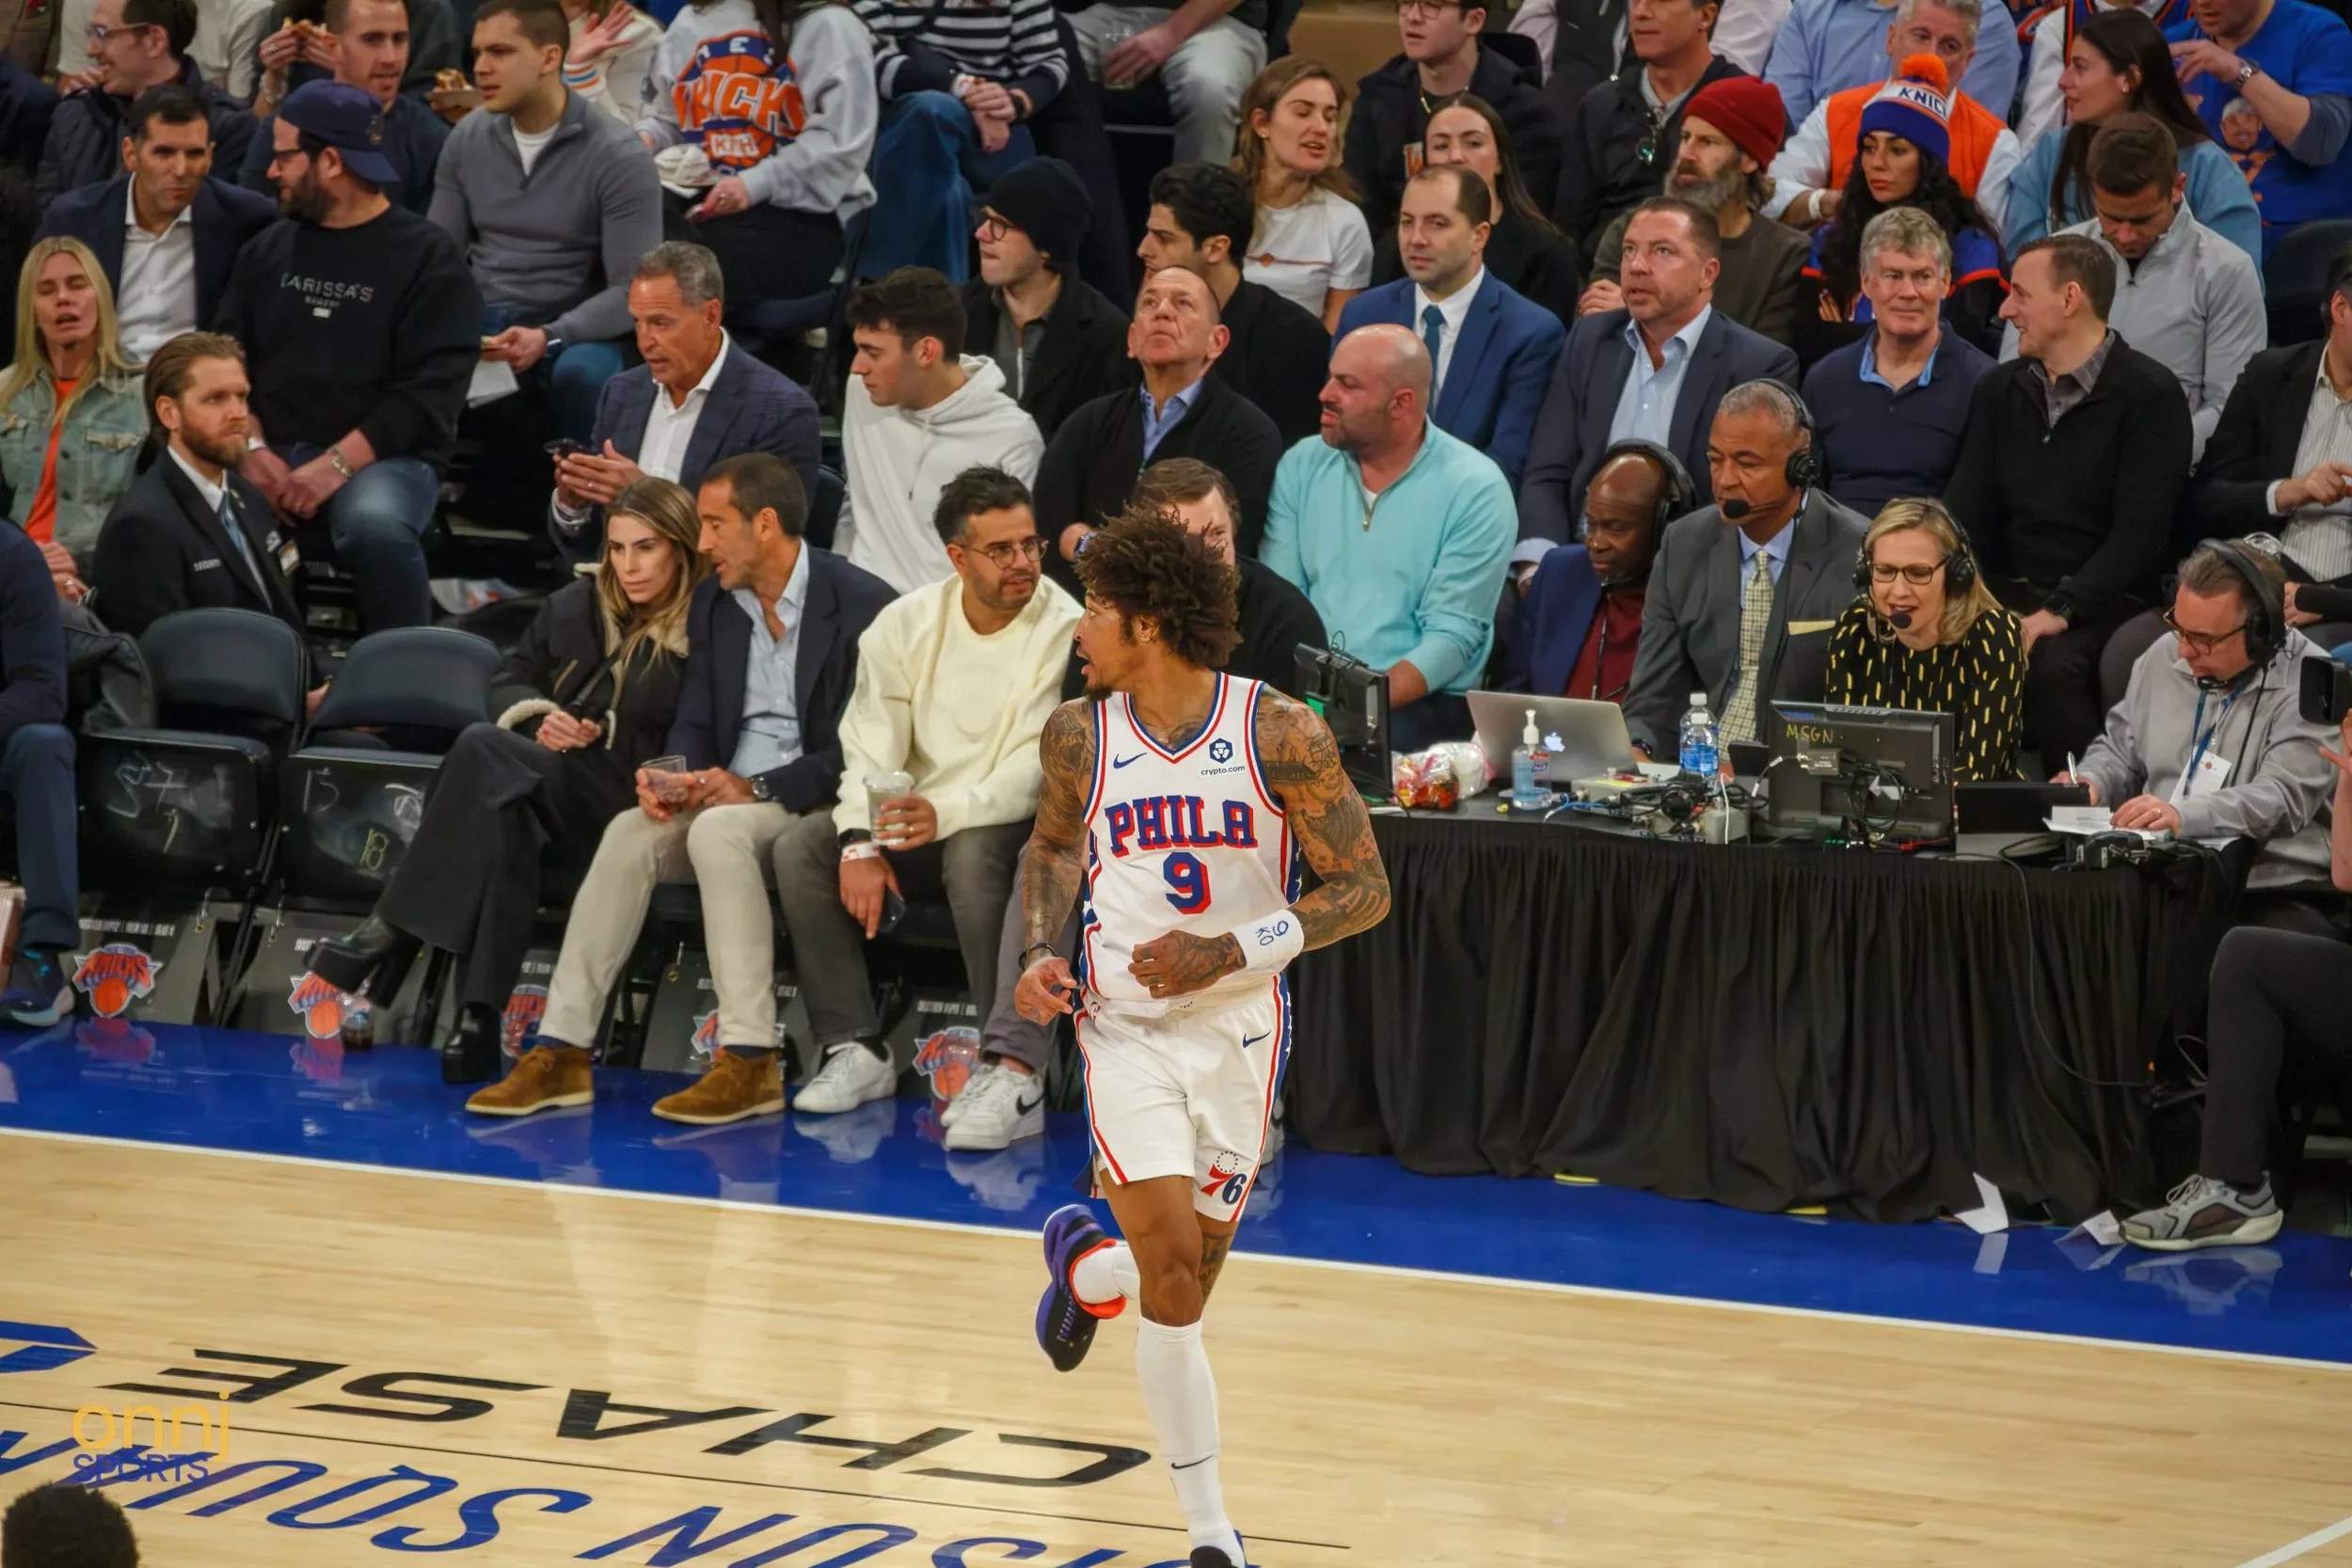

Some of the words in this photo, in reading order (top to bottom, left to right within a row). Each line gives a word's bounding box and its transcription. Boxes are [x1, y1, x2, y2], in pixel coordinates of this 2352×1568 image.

[1787, 723, 1834, 744] MSGN
[1200, 764, 1246, 776] crypto.com
[1104, 795, 1259, 859] PHILA
[1163, 851, 1213, 915] 9
[1200, 1163, 1248, 1205] 76
[93, 1348, 1152, 1489] CHASE
